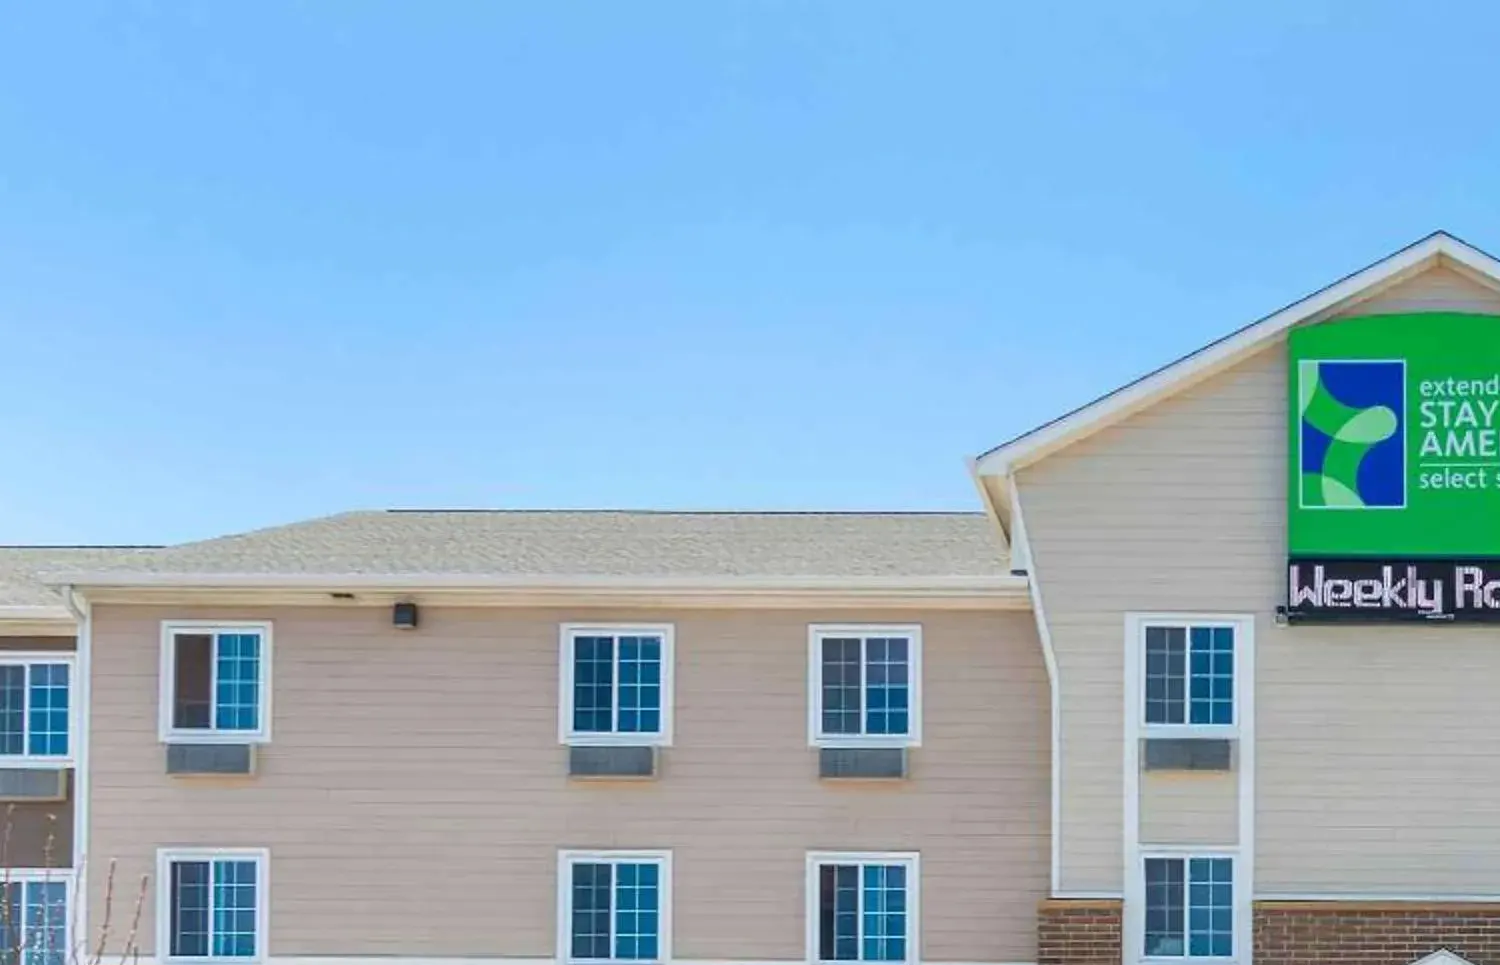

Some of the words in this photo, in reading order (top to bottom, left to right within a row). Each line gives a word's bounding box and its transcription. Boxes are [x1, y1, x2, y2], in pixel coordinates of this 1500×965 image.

[1420, 400, 1500, 428] STAY
[1419, 467, 1488, 489] select
[1290, 565, 1443, 614] Weekly
